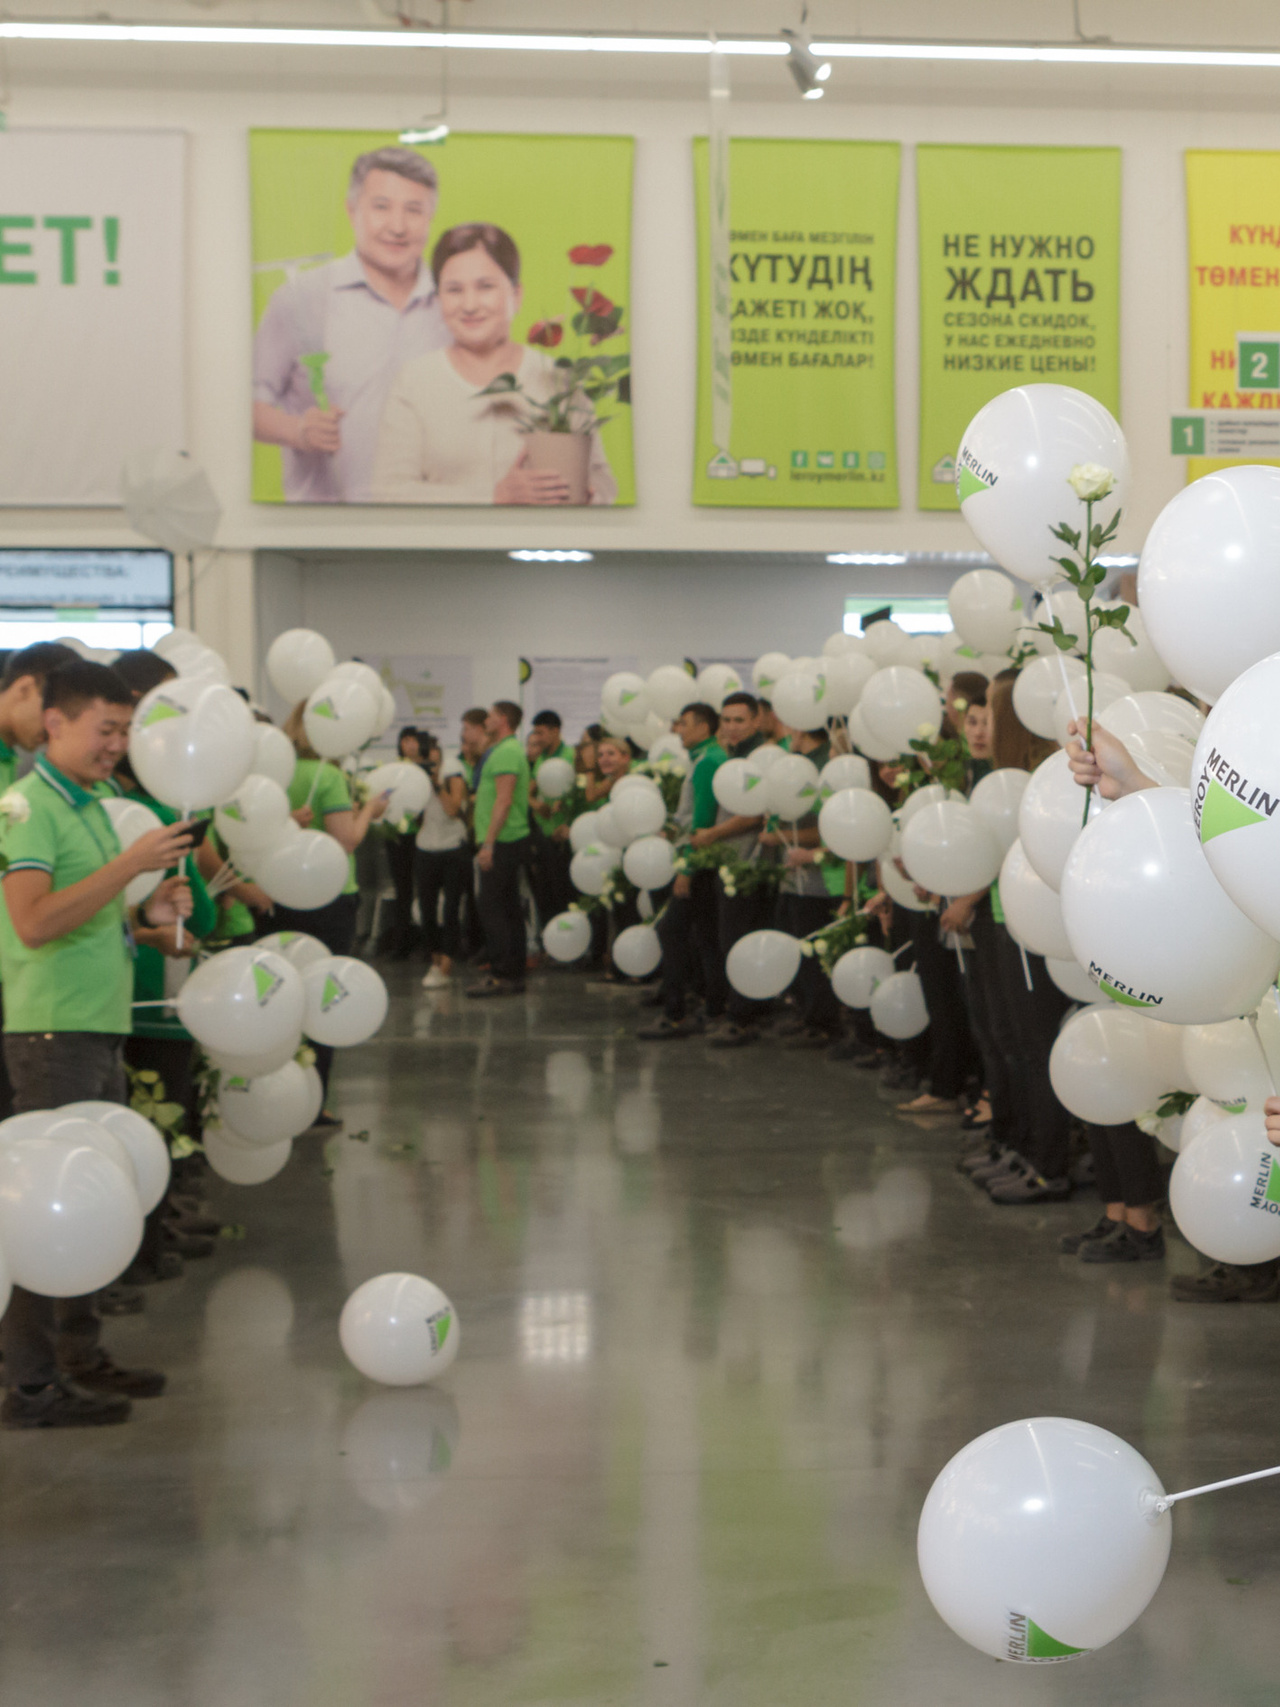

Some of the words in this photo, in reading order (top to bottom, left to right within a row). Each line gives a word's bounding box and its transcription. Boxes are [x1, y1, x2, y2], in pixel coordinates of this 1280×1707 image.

[730, 231, 768, 242] ӨМЕН
[943, 234, 980, 258] НЕ
[990, 234, 1095, 259] НУЖНО
[1195, 266, 1280, 287] ТӨМЕН
[945, 267, 1095, 309] ЖДАТЬ
[730, 300, 806, 321] АЖЕТІ
[943, 312, 1013, 327] СЕЗОНА
[1018, 313, 1096, 330] СКИДОК,
[731, 328, 770, 344] ІЗДЕ
[775, 329, 874, 345] КҮНДЕЛІКТІ
[945, 334, 954, 347] У
[958, 334, 989, 347] НАС
[994, 334, 1095, 350] ЕЖЕДНЕВНО
[731, 351, 783, 367] ӨМЕН
[788, 351, 874, 369] БАҒАЛАР!
[943, 355, 1024, 371] НИЗКИЕ
[1030, 356, 1096, 374] ЦЕНЫ!
[1251, 352, 1268, 379] 2
[1183, 425, 1195, 447] 1
[962, 446, 998, 486] MERLIN
[1206, 747, 1280, 816] MERLIN
[1089, 960, 1163, 1004] MERLIN
[1250, 1152, 1272, 1208] MERLIN
